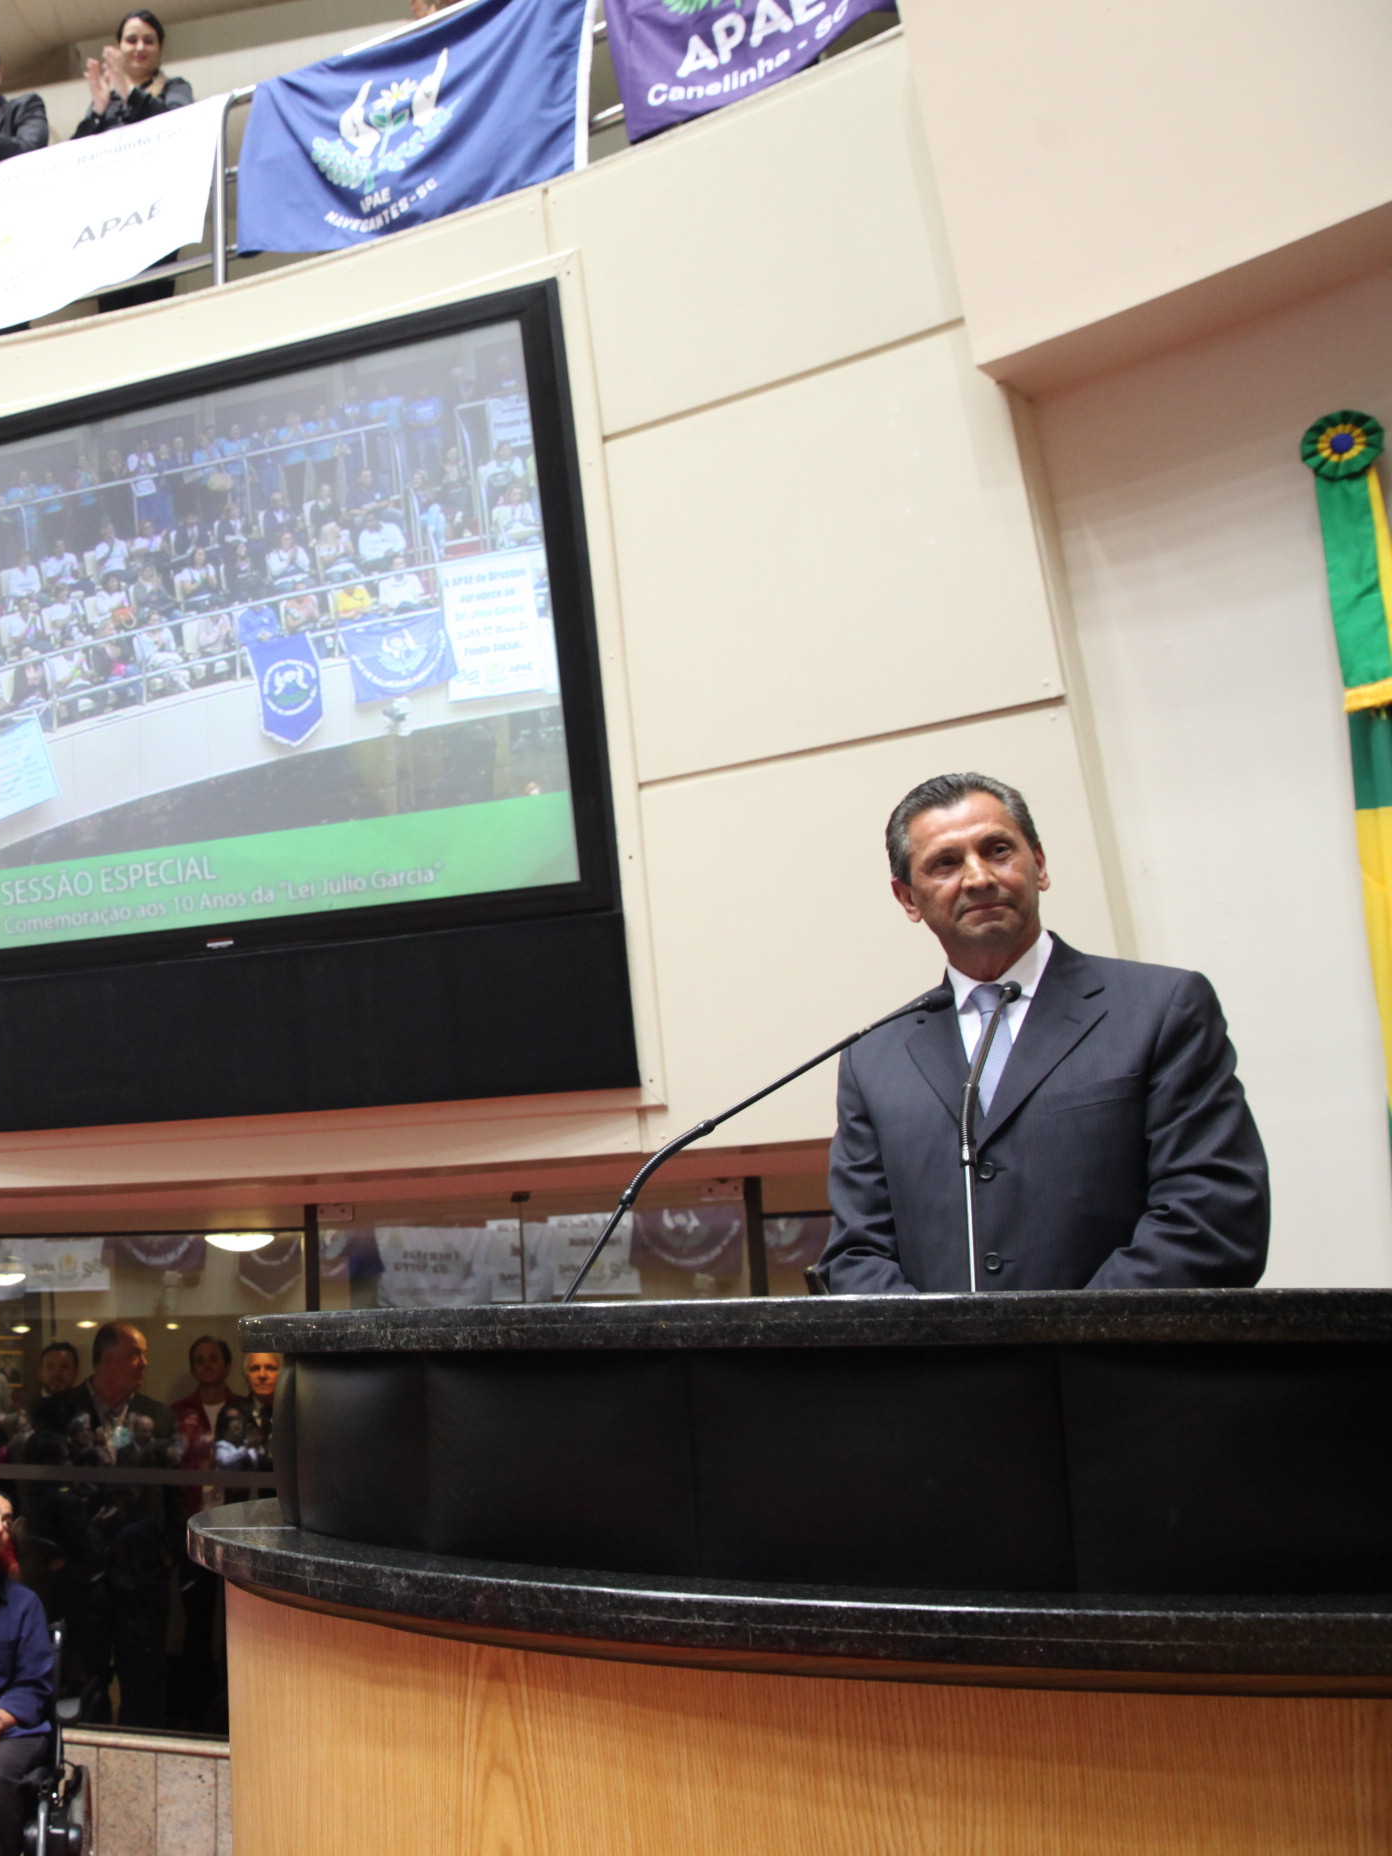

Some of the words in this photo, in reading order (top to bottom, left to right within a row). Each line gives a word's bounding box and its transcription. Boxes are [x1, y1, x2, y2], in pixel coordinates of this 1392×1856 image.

[676, 0, 826, 78] APAE
[647, 48, 791, 106] Canelinha
[72, 195, 165, 250] APAE
[0, 869, 94, 906] SESSÃO
[100, 855, 218, 893] ESPECIAL
[3, 905, 132, 935] Comemoração
[135, 901, 168, 918] aos
[175, 895, 195, 913] 10
[199, 891, 246, 911] Anos
[250, 885, 275, 904] da
[321, 873, 367, 897] Julio
